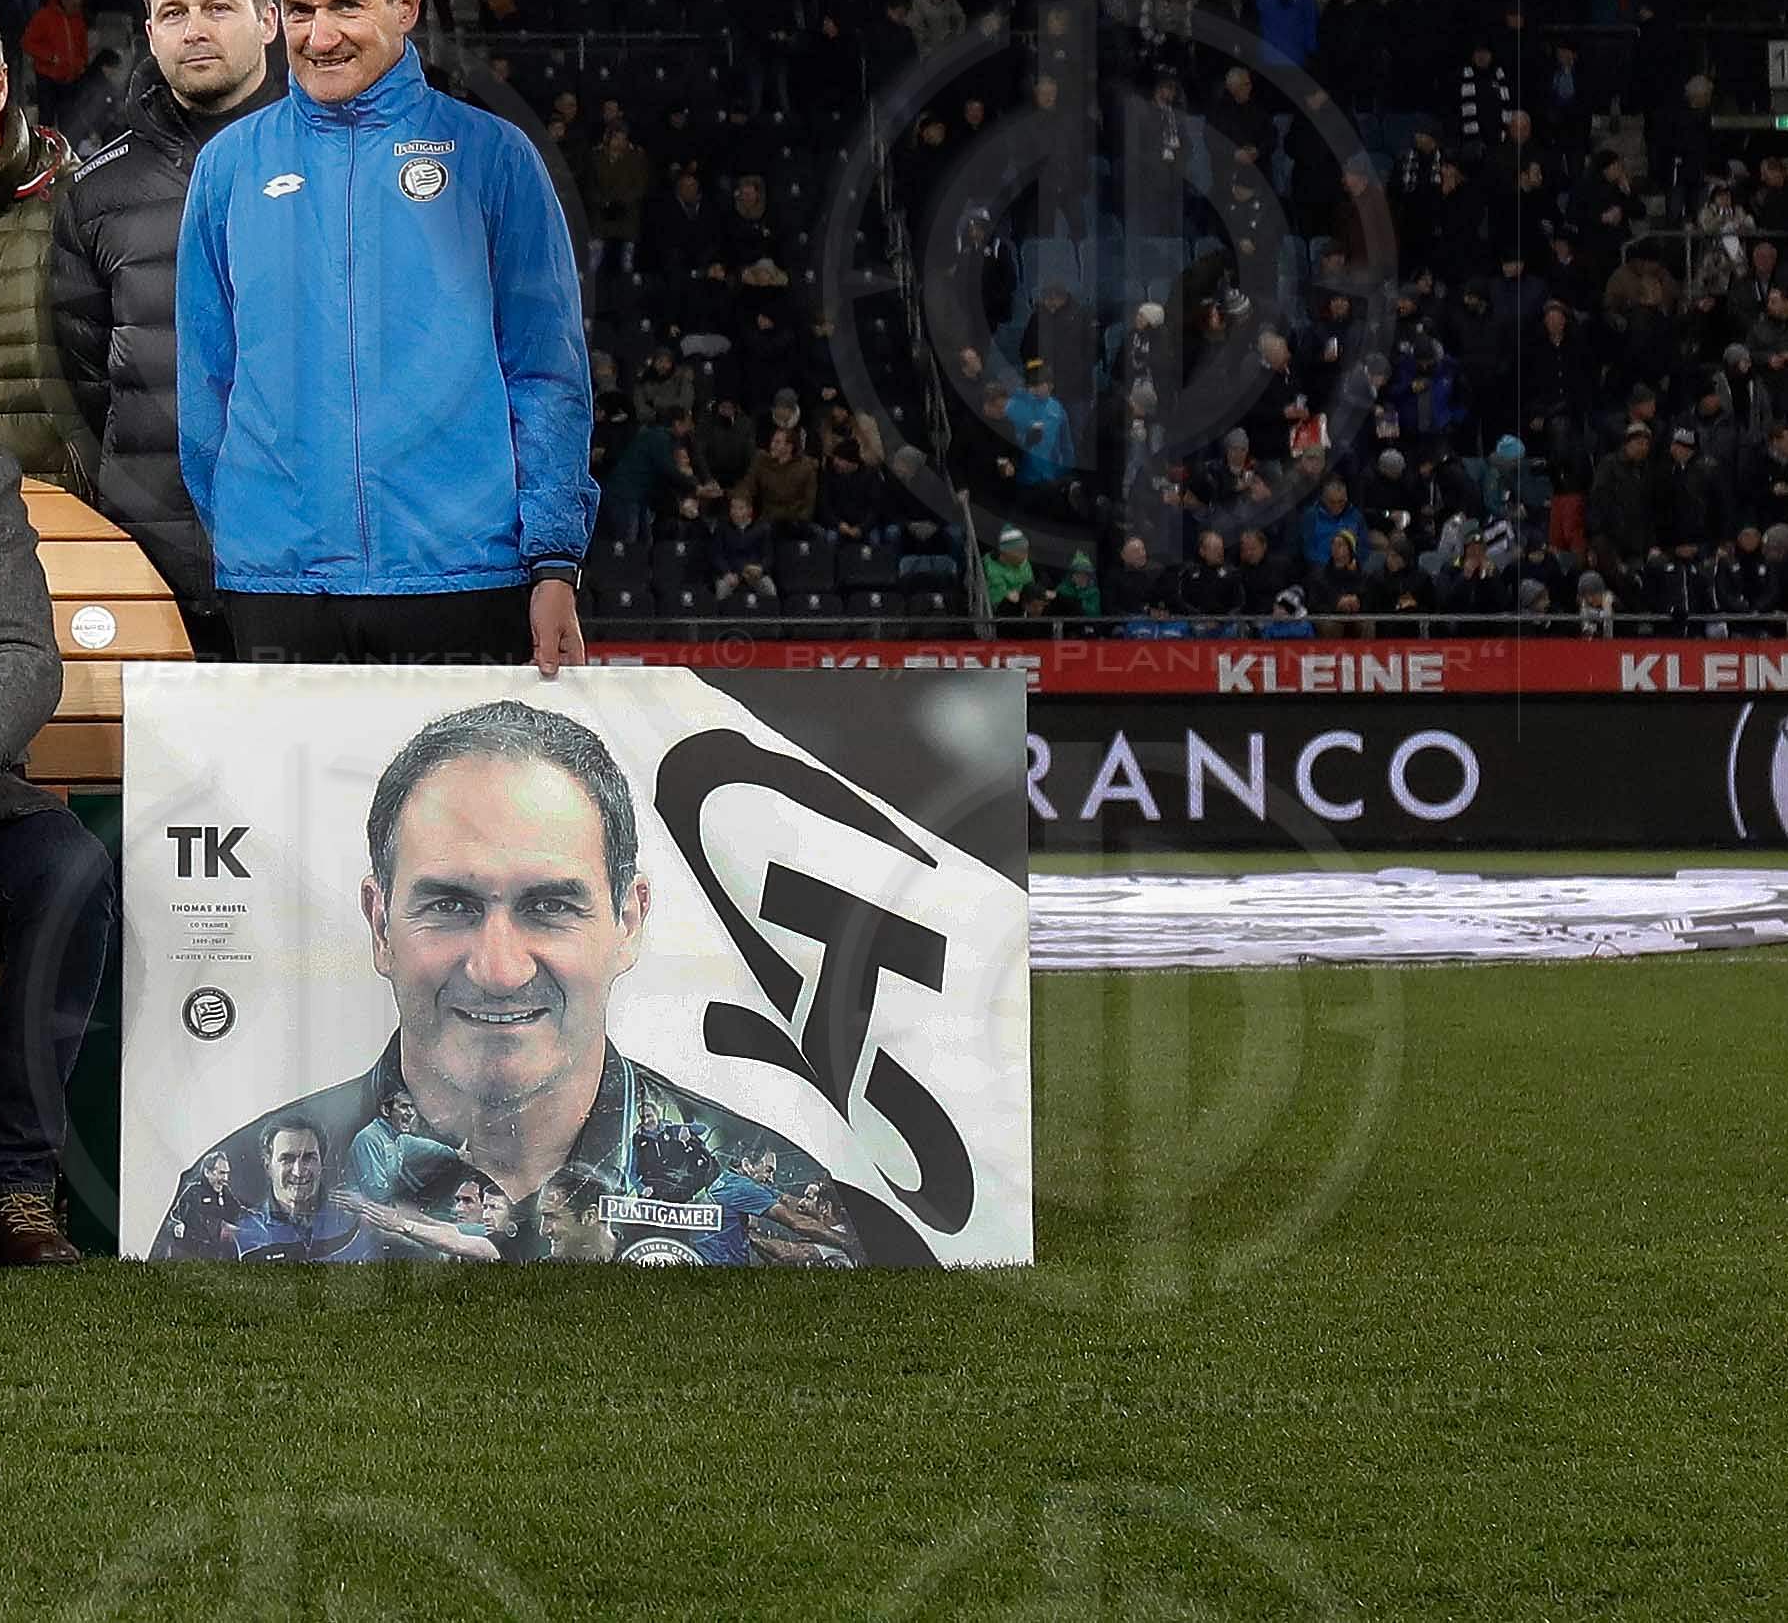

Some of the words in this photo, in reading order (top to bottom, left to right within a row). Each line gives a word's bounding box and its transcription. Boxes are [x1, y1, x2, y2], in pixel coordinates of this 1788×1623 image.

[1217, 653, 1445, 693] KLEINE
[1026, 728, 1480, 822] RANCO
[166, 826, 252, 878] TK
[170, 904, 212, 912] THOMAS
[607, 1199, 715, 1226] PUNTIGAMER
